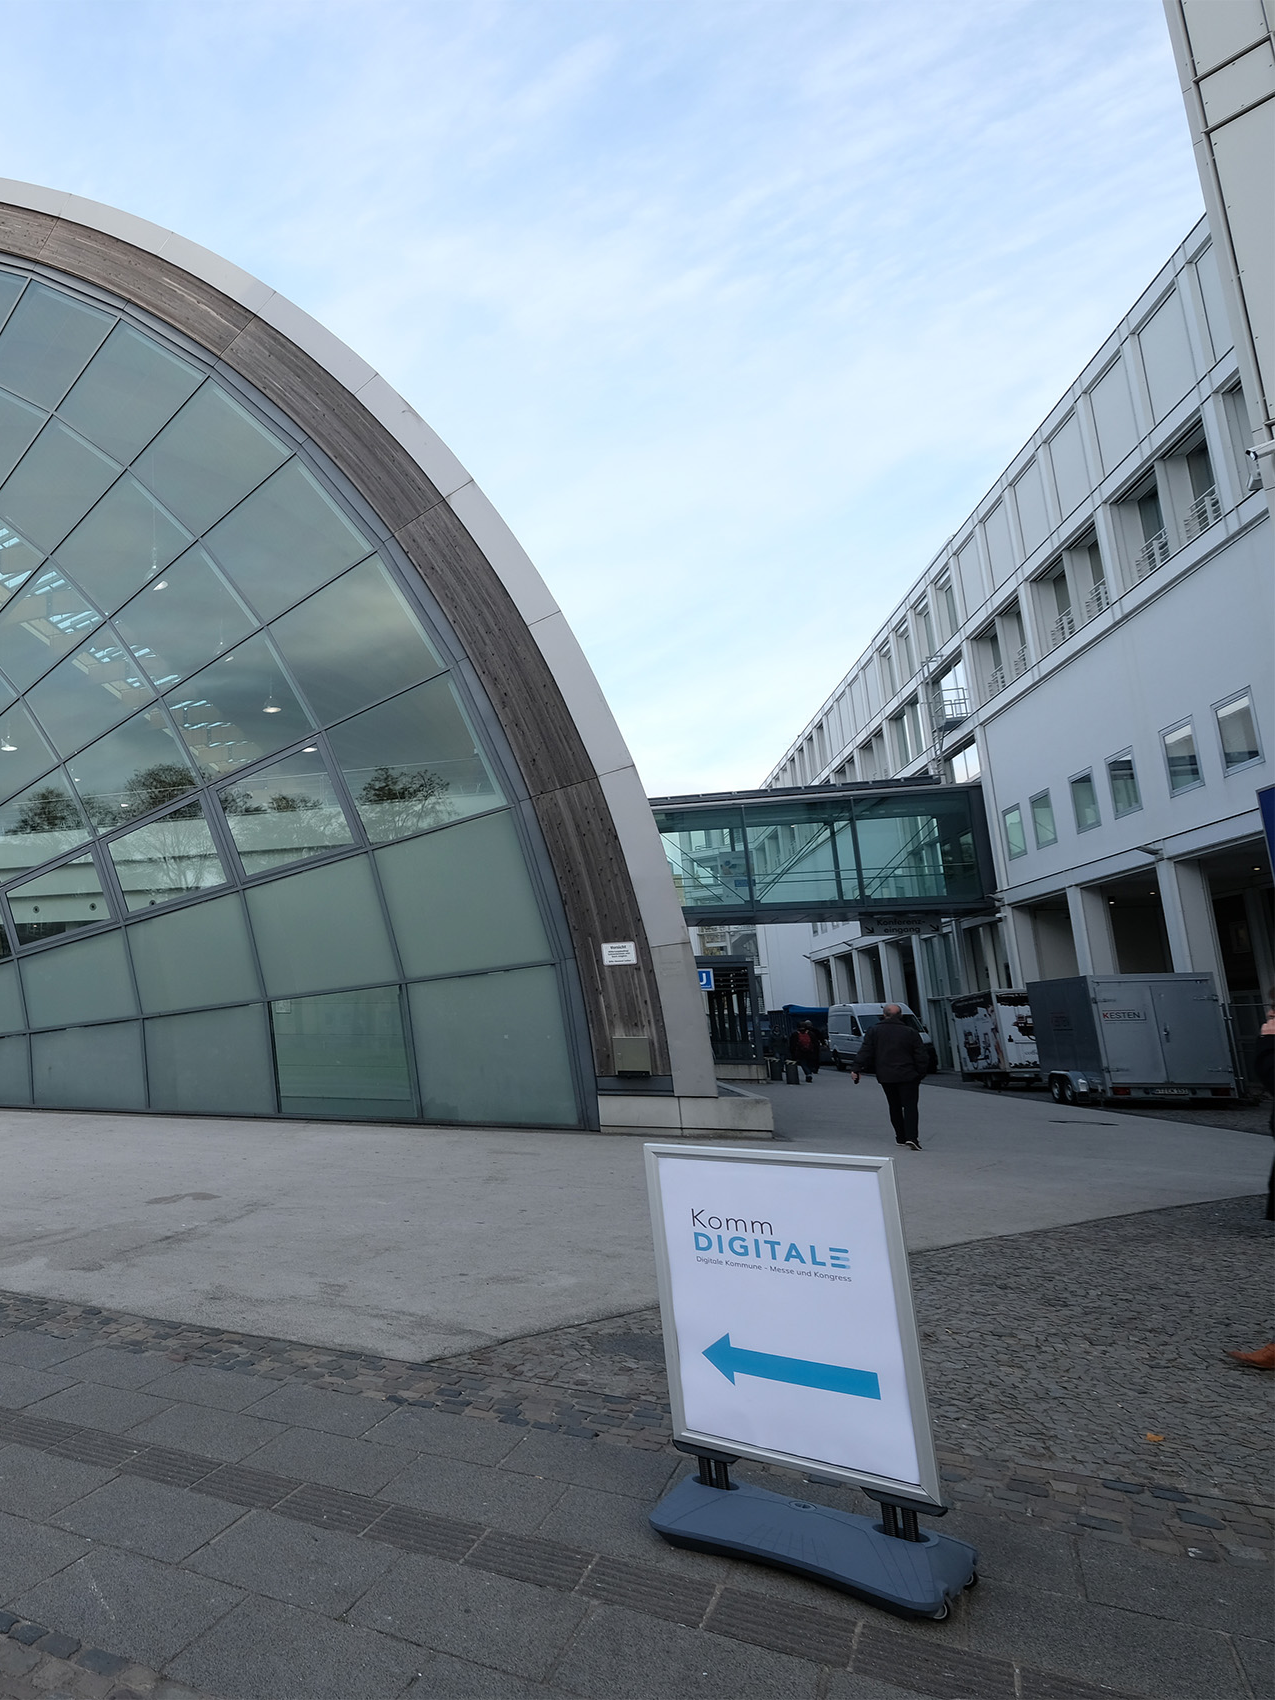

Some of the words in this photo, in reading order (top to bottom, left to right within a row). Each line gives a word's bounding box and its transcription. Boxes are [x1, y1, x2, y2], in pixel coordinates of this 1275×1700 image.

[883, 926, 921, 934] eingang
[1102, 1011, 1141, 1019] KESTEN
[691, 1208, 774, 1236] Komm
[693, 1231, 851, 1270] DIGITALE
[696, 1255, 723, 1266] Digitale
[725, 1259, 762, 1271] Kommune
[769, 1265, 795, 1275] Messe
[796, 1269, 812, 1277] und
[814, 1271, 852, 1283] Kongress
